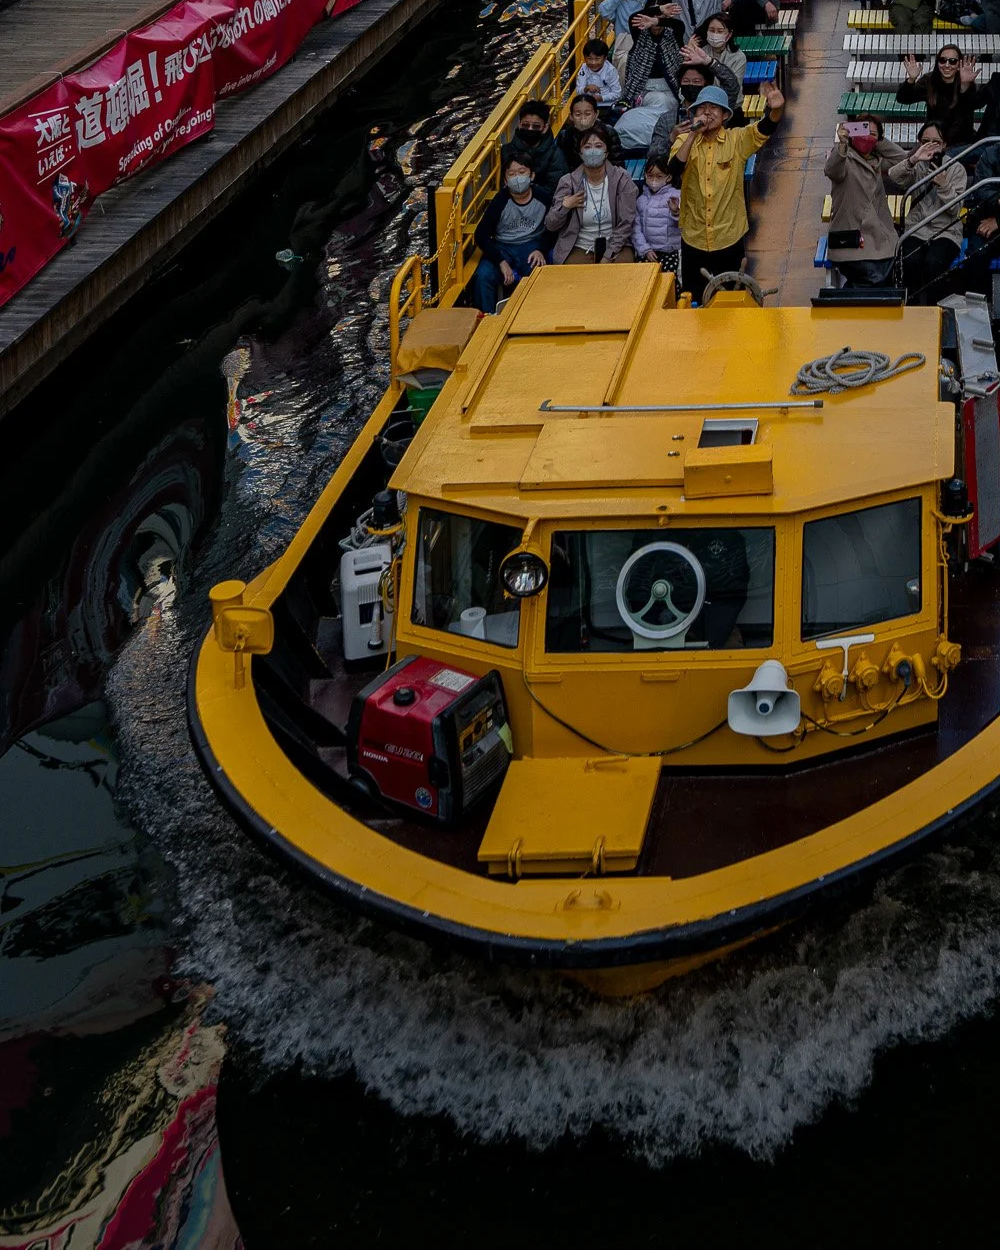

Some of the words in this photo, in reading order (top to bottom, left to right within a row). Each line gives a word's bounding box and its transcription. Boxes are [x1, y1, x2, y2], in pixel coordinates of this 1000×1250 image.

[34, 113, 71, 147] 大阪と
[118, 135, 153, 173] Speaking
[153, 123, 165, 142] of
[363, 750, 389, 763] HONDA
